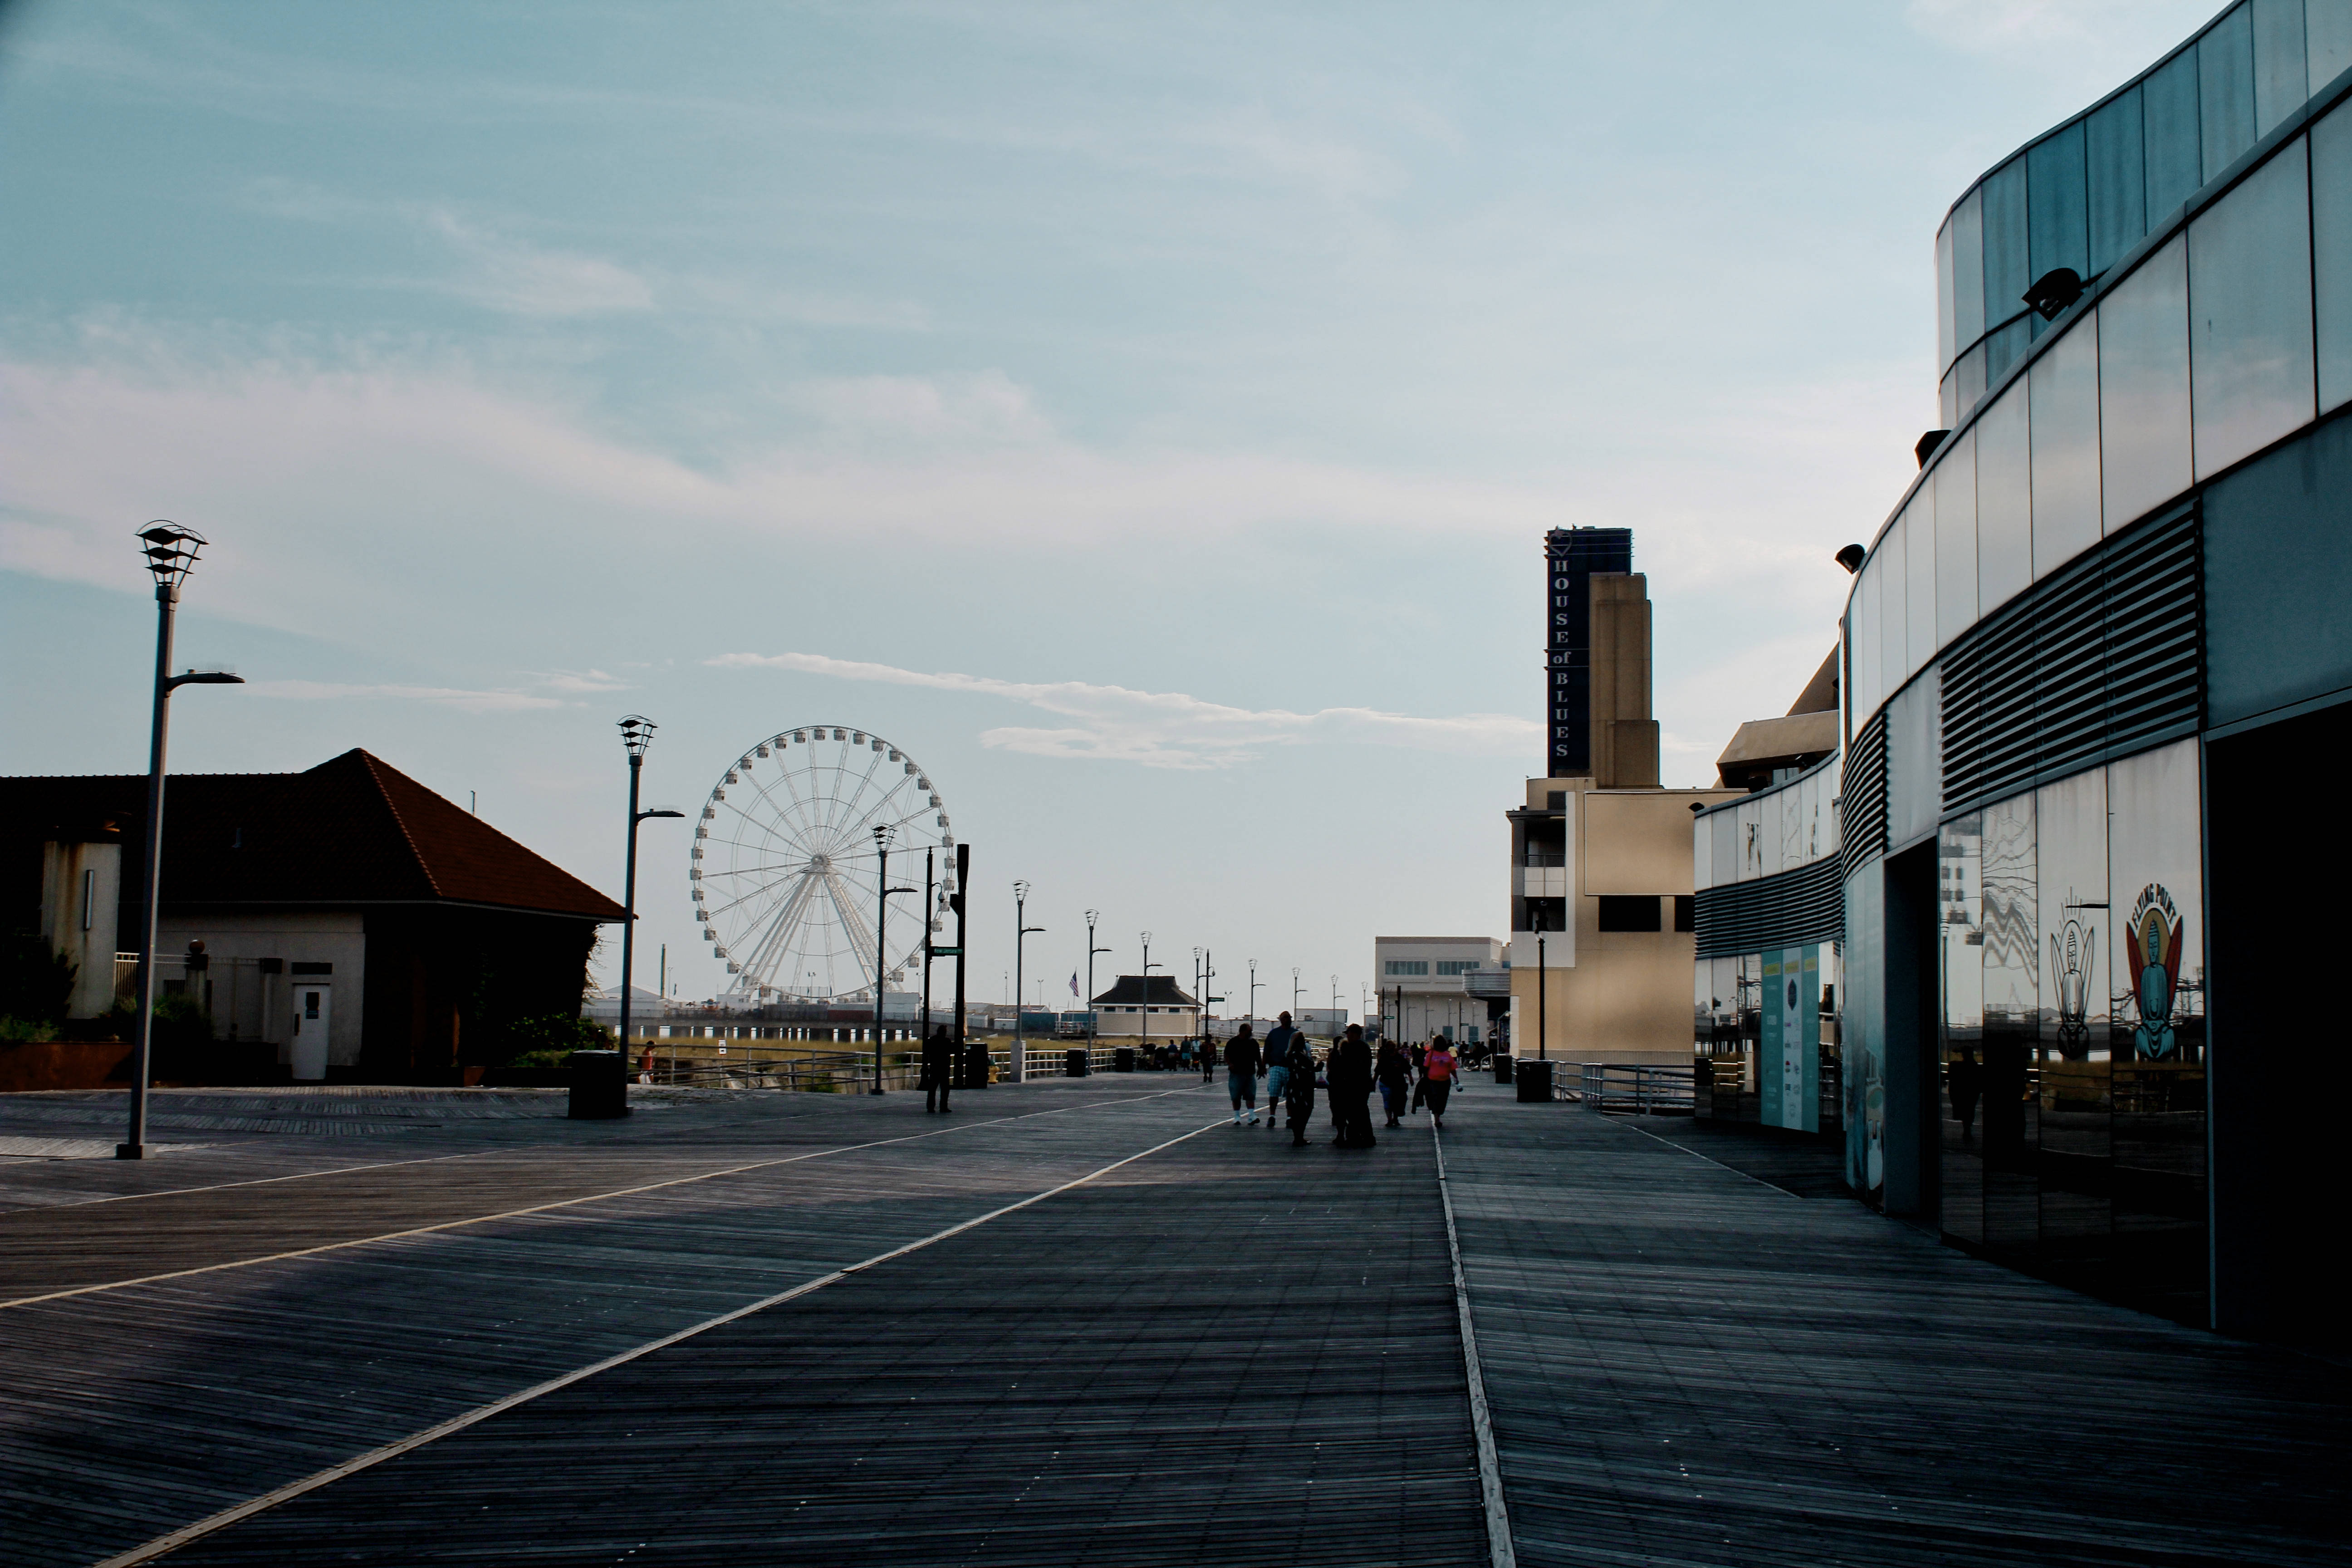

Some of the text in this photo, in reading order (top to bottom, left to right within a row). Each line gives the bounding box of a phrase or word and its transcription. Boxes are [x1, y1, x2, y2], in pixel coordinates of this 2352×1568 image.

[1553, 560, 1572, 757] HOUSE of BLUES
[2132, 883, 2176, 929] FLYING POINT
